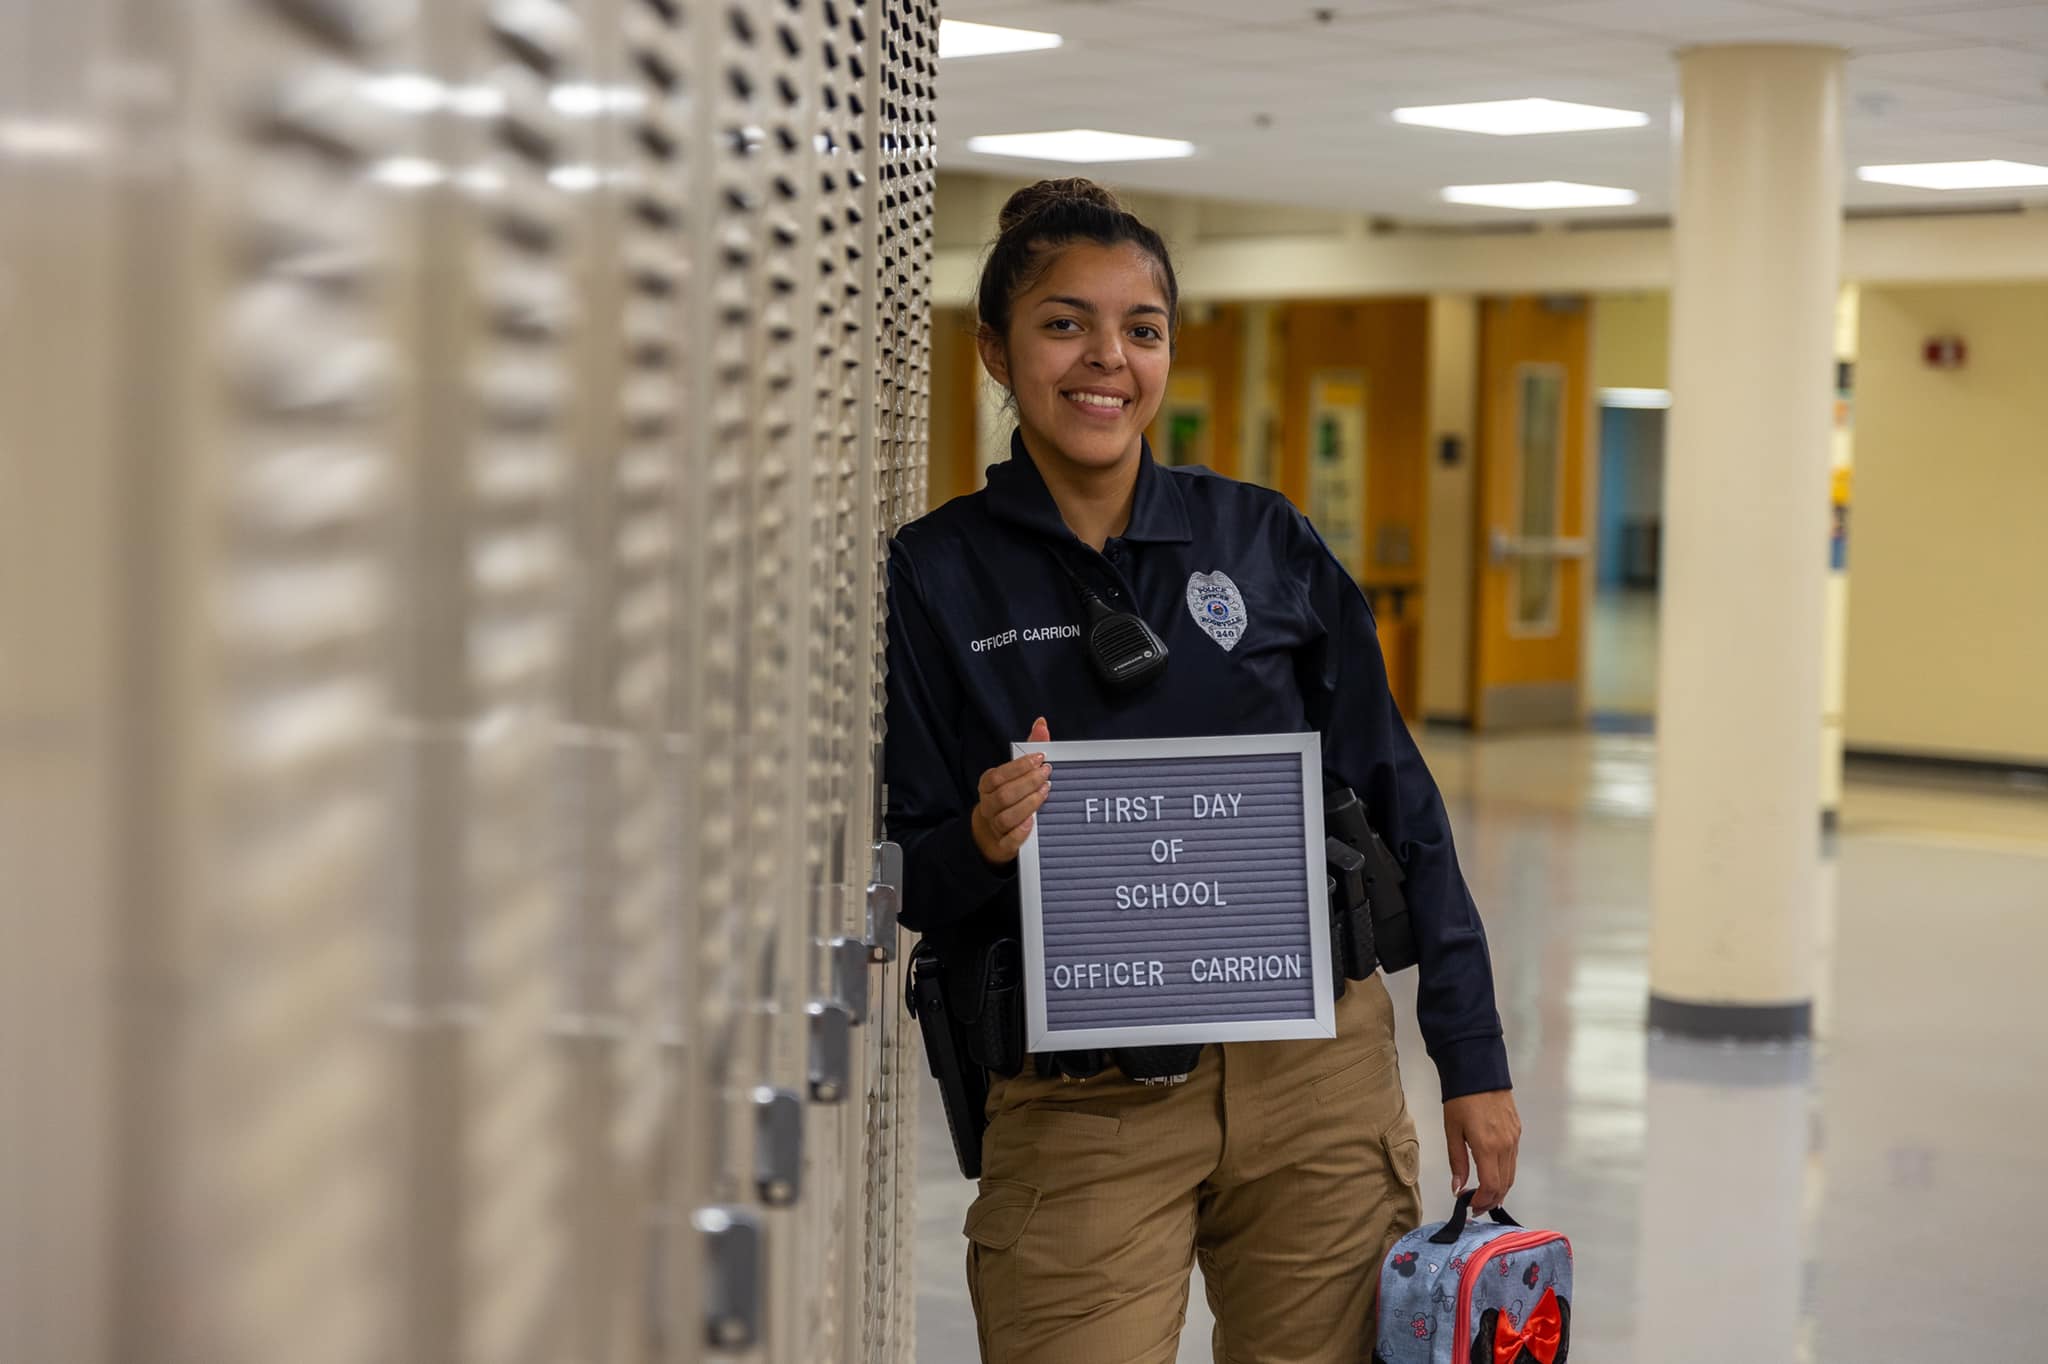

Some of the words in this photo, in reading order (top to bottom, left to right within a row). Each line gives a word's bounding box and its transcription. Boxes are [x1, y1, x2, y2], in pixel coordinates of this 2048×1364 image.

[1199, 585, 1227, 593] POLICE
[971, 629, 1017, 652] OFFICER
[1022, 624, 1080, 641] CARRION
[1085, 795, 1164, 823] FIRST
[1193, 792, 1242, 818] DAY
[1151, 838, 1183, 863] OF
[1115, 880, 1227, 909] SCHOOL
[1053, 960, 1164, 989] OFFICER
[1191, 953, 1301, 982] CARRION
